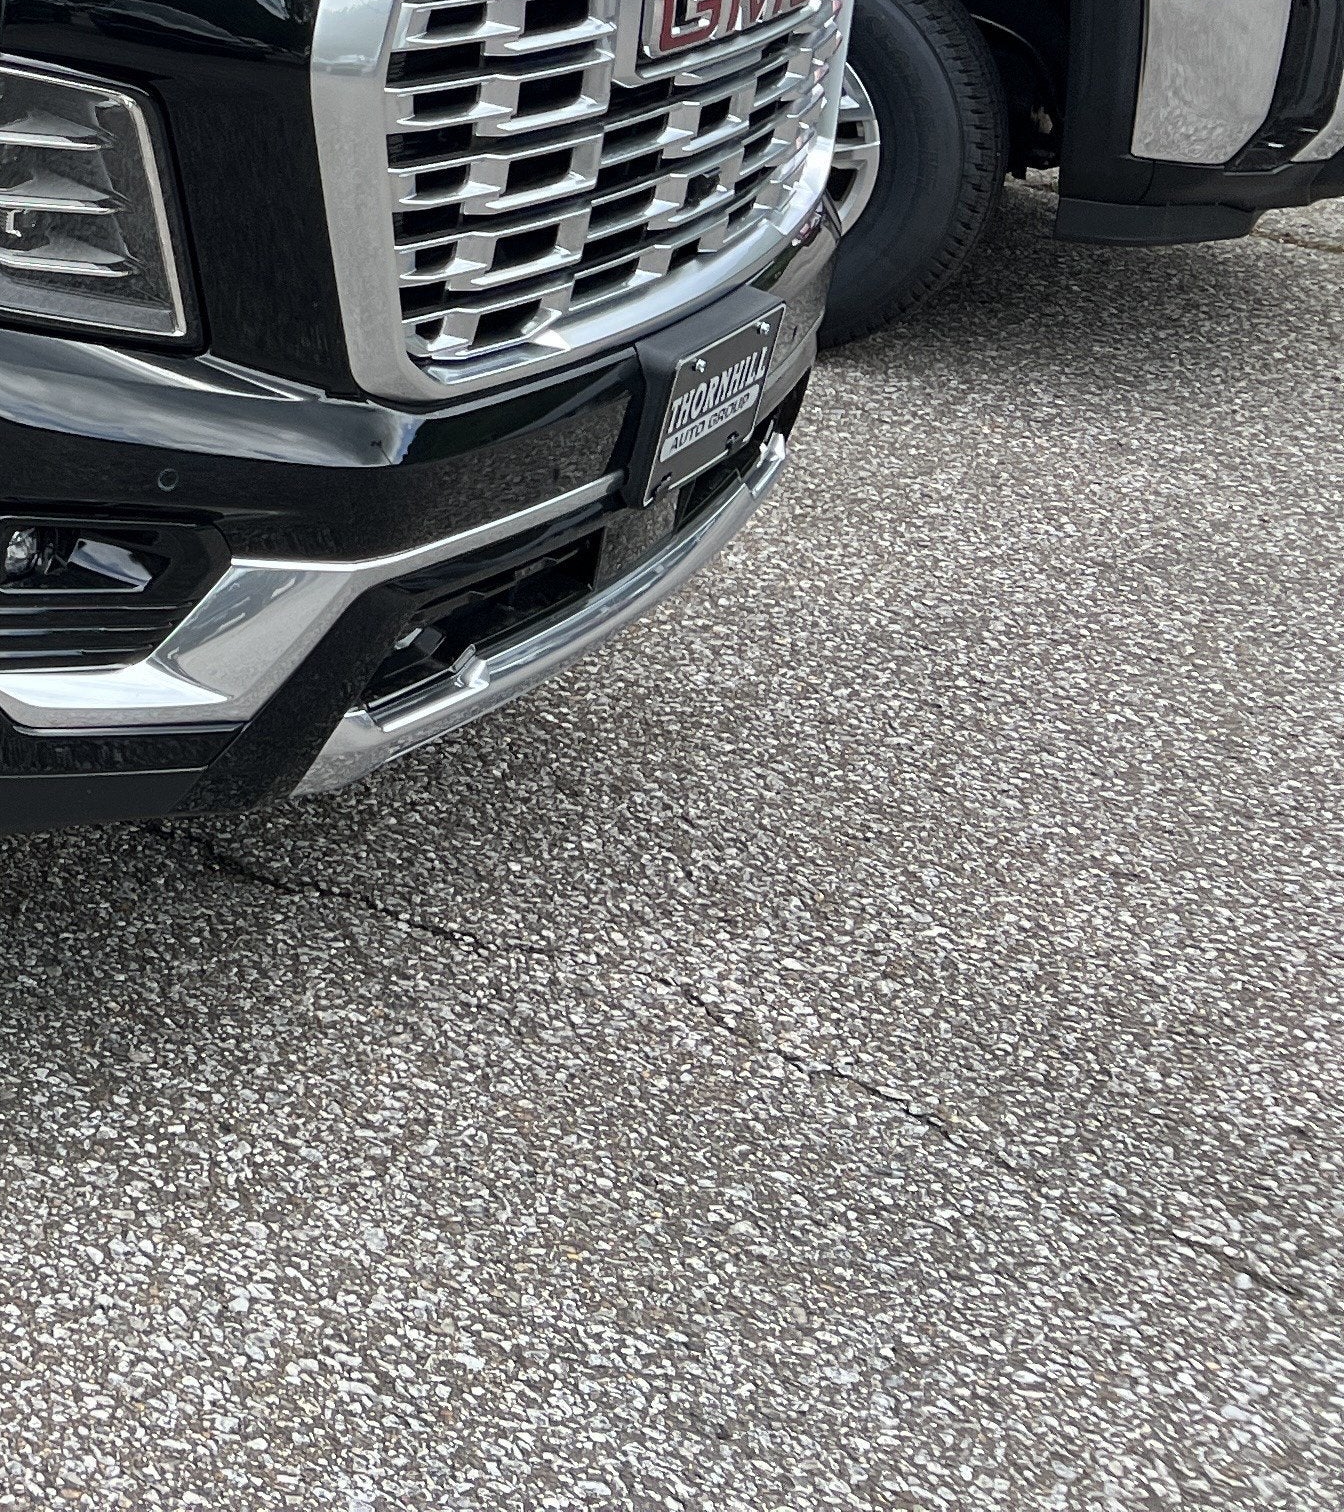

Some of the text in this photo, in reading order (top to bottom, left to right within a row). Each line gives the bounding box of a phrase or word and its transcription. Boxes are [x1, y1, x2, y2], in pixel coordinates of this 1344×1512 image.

[667, 346, 769, 434] THORNHILL
[670, 392, 751, 452] AUTO GROUP
